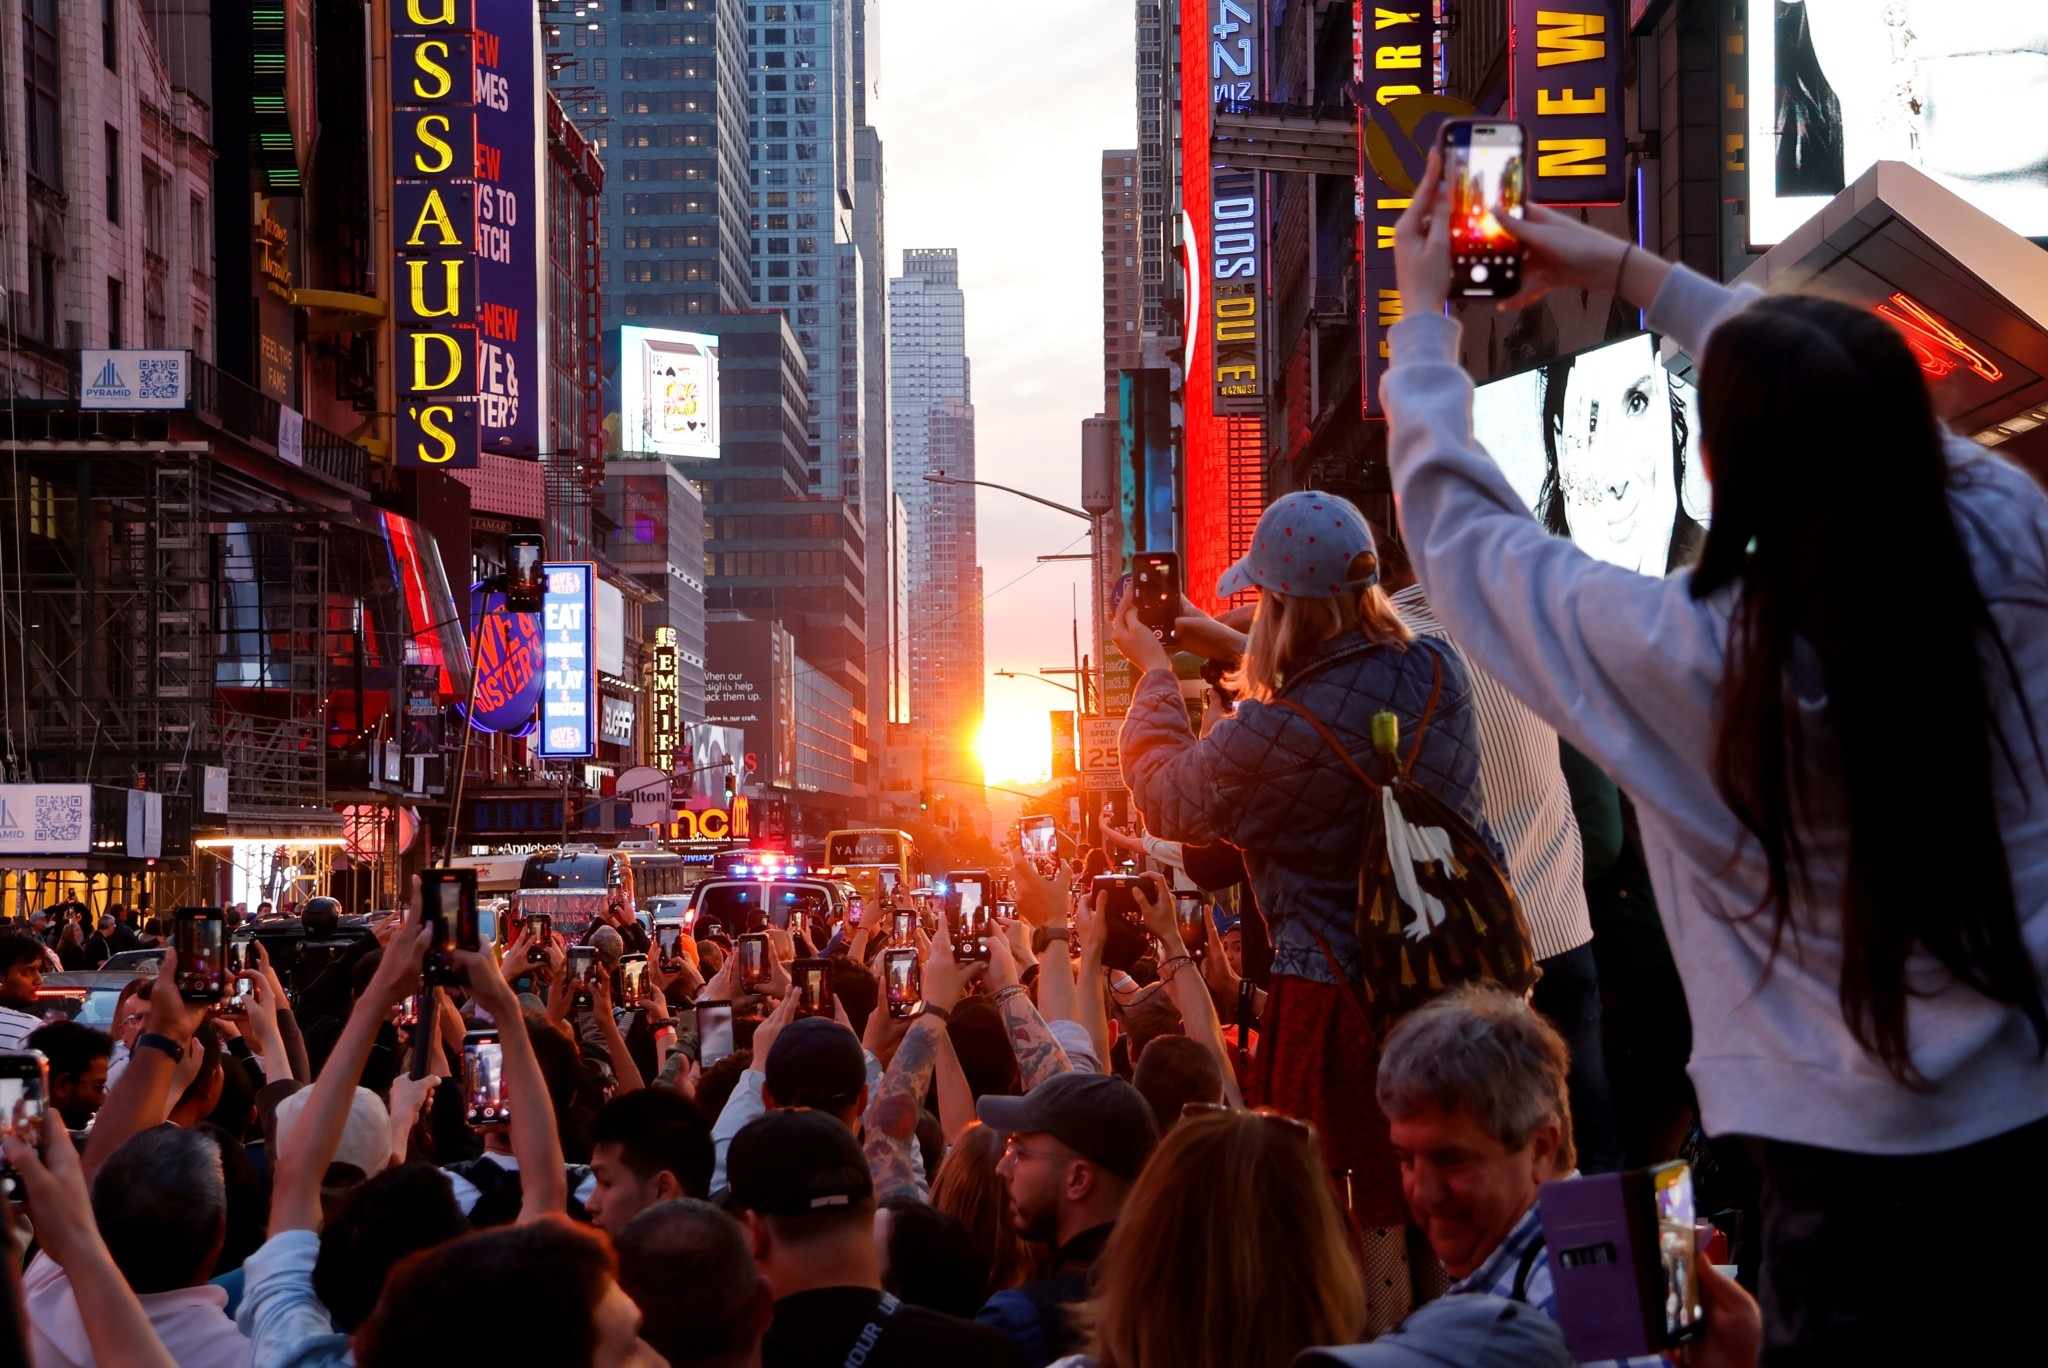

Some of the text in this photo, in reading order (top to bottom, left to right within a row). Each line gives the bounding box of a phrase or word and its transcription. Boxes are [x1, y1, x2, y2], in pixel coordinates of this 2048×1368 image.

[1537, 10, 1606, 177] NEW
[496, 188, 516, 227] TO
[1214, 174, 1256, 279] UDIOS
[1216, 297, 1256, 382] DUKE
[262, 334, 292, 370] FEEL THE
[268, 367, 286, 395] FAME
[505, 352, 519, 397] &
[86, 389, 131, 397] PYRAMID
[476, 519, 506, 531] LAMAR
[546, 603, 584, 630] EAT
[560, 630, 570, 642] &
[546, 642, 584, 658] DRINK
[560, 658, 570, 670] &
[546, 670, 584, 689] PLAY
[728, 673, 743, 681] our
[560, 689, 570, 702] &
[704, 682, 754, 693] sights help
[704, 692, 762, 702] ack them up.
[1105, 693, 1130, 706] SIM30
[547, 702, 585, 717] WATCH
[657, 654, 675, 771] EMPIRE
[1088, 748, 1120, 768] 25
[475, 802, 563, 830] DINER
[503, 843, 562, 855] Applebee's
[835, 845, 894, 855] YANKEE
